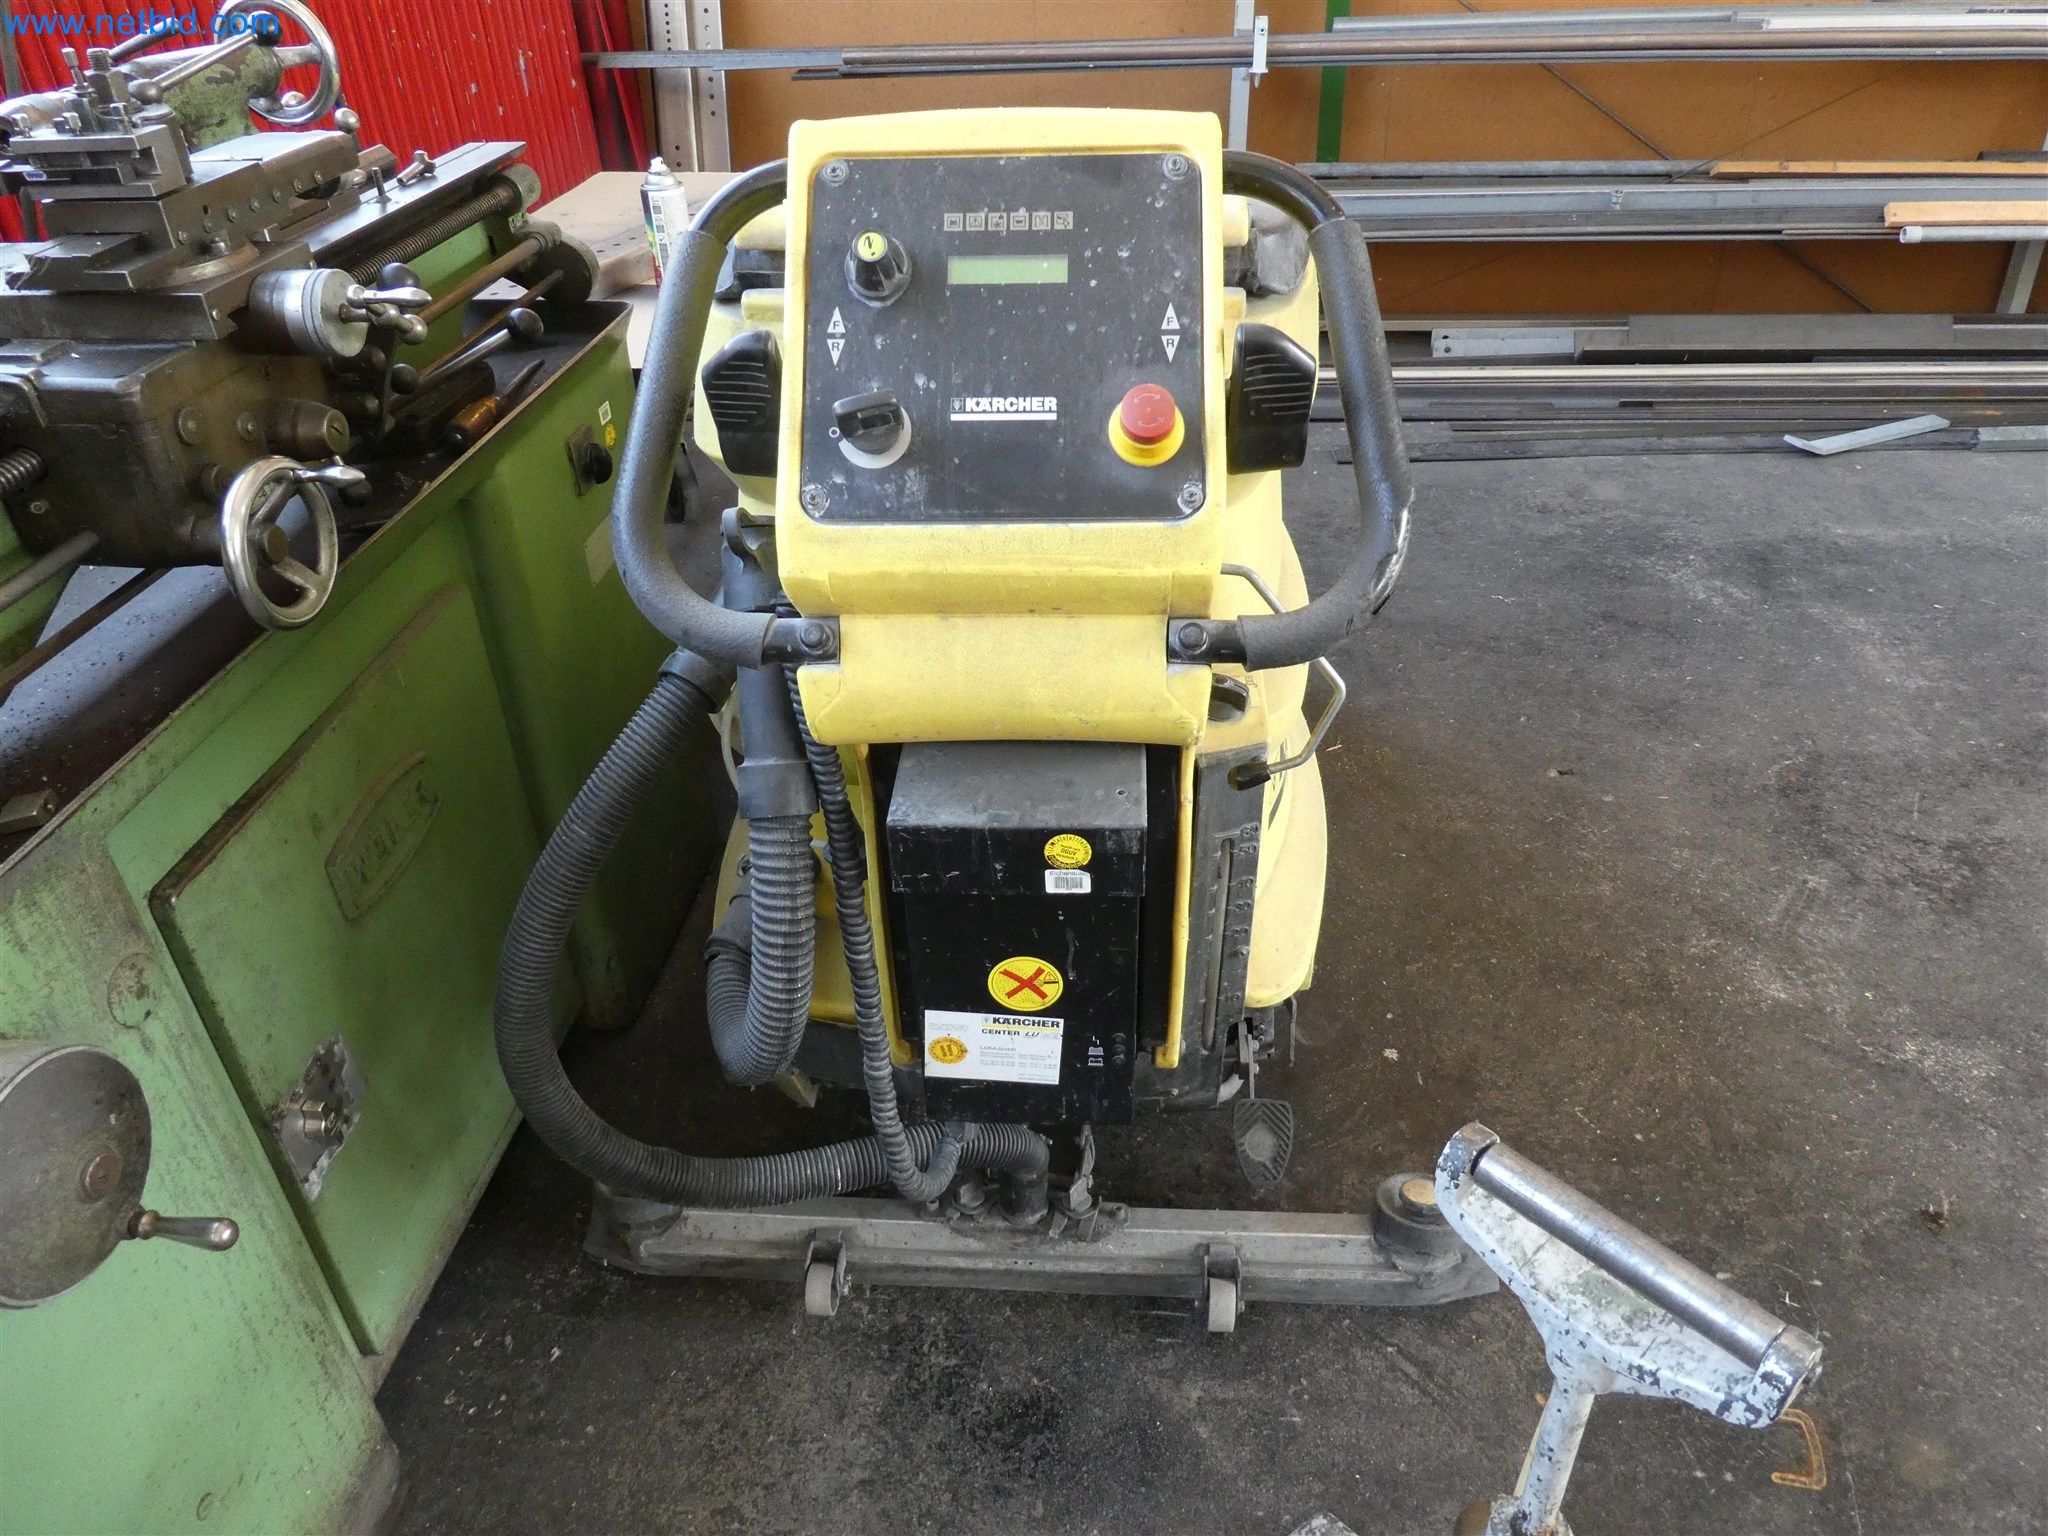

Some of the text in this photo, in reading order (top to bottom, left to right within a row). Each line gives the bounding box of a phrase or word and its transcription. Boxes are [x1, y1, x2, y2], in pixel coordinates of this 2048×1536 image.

[832, 320, 840, 330] F
[1166, 316, 1175, 327] F
[831, 341, 841, 351] R
[1166, 338, 1175, 348] R
[965, 396, 1058, 412] KÄRCHER
[992, 1016, 1060, 1029] KÄRCHER
[981, 1028, 1020, 1036] CENTER
